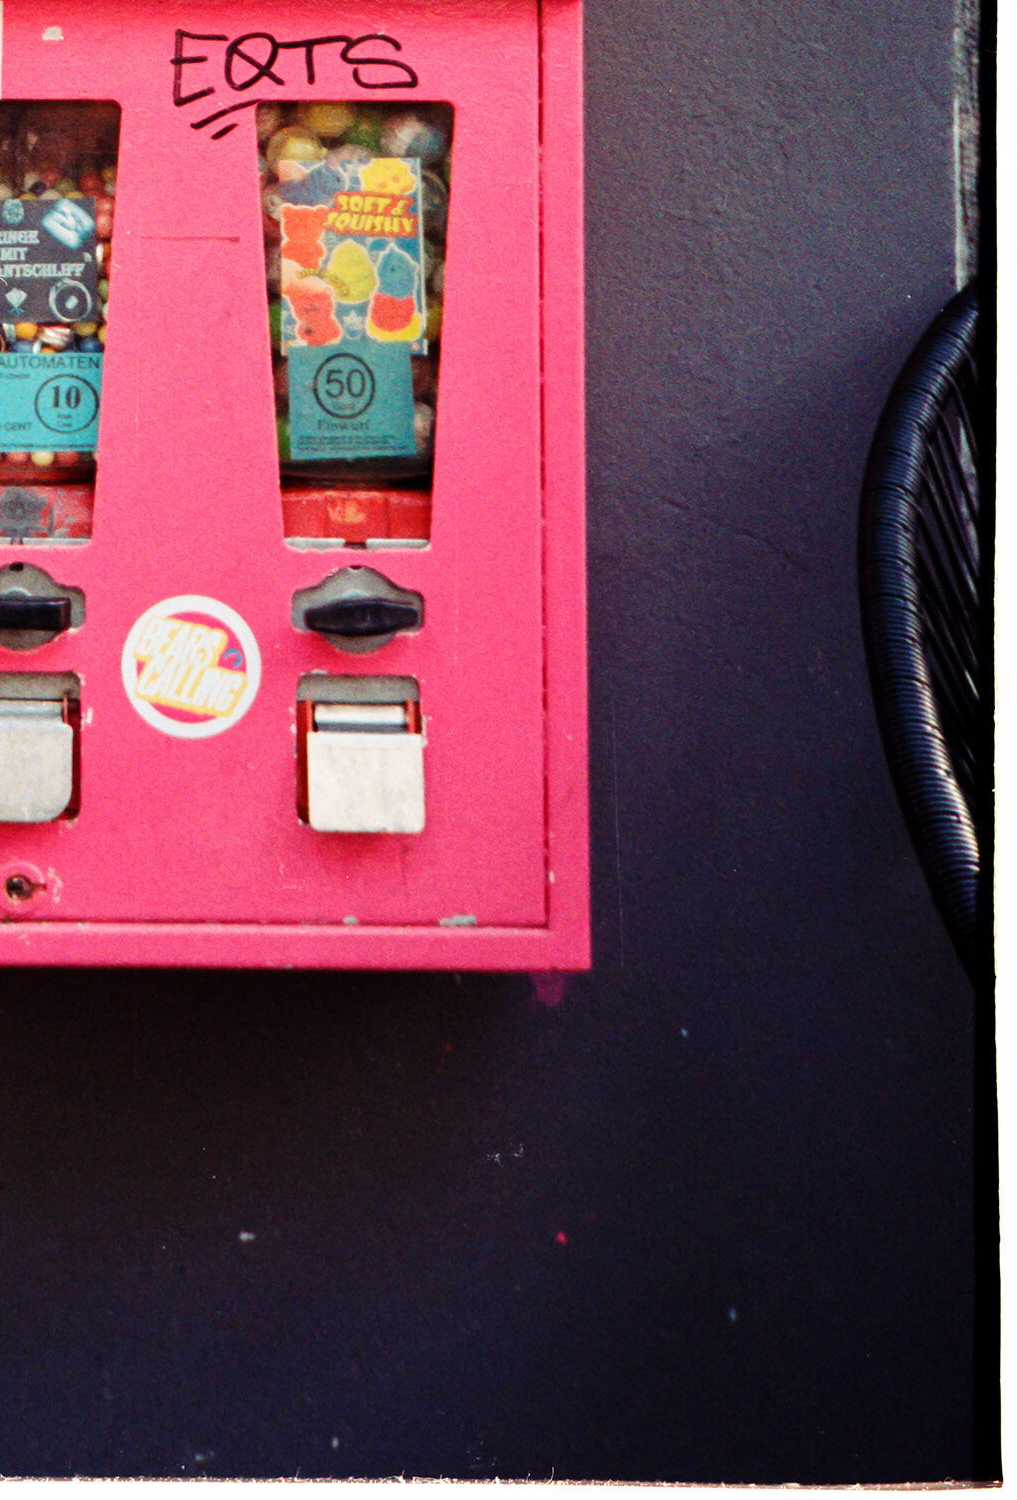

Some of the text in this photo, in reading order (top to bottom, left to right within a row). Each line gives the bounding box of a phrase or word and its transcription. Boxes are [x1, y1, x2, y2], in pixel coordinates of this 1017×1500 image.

[337, 194, 393, 215] SOFT
[323, 211, 415, 234] SQUISHY
[0, 247, 29, 261] MIT
[325, 369, 366, 398] 50
[52, 385, 82, 410] 10
[4, 421, 33, 432] CENT
[137, 616, 224, 668] BEARS
[136, 656, 245, 713] CALLING
